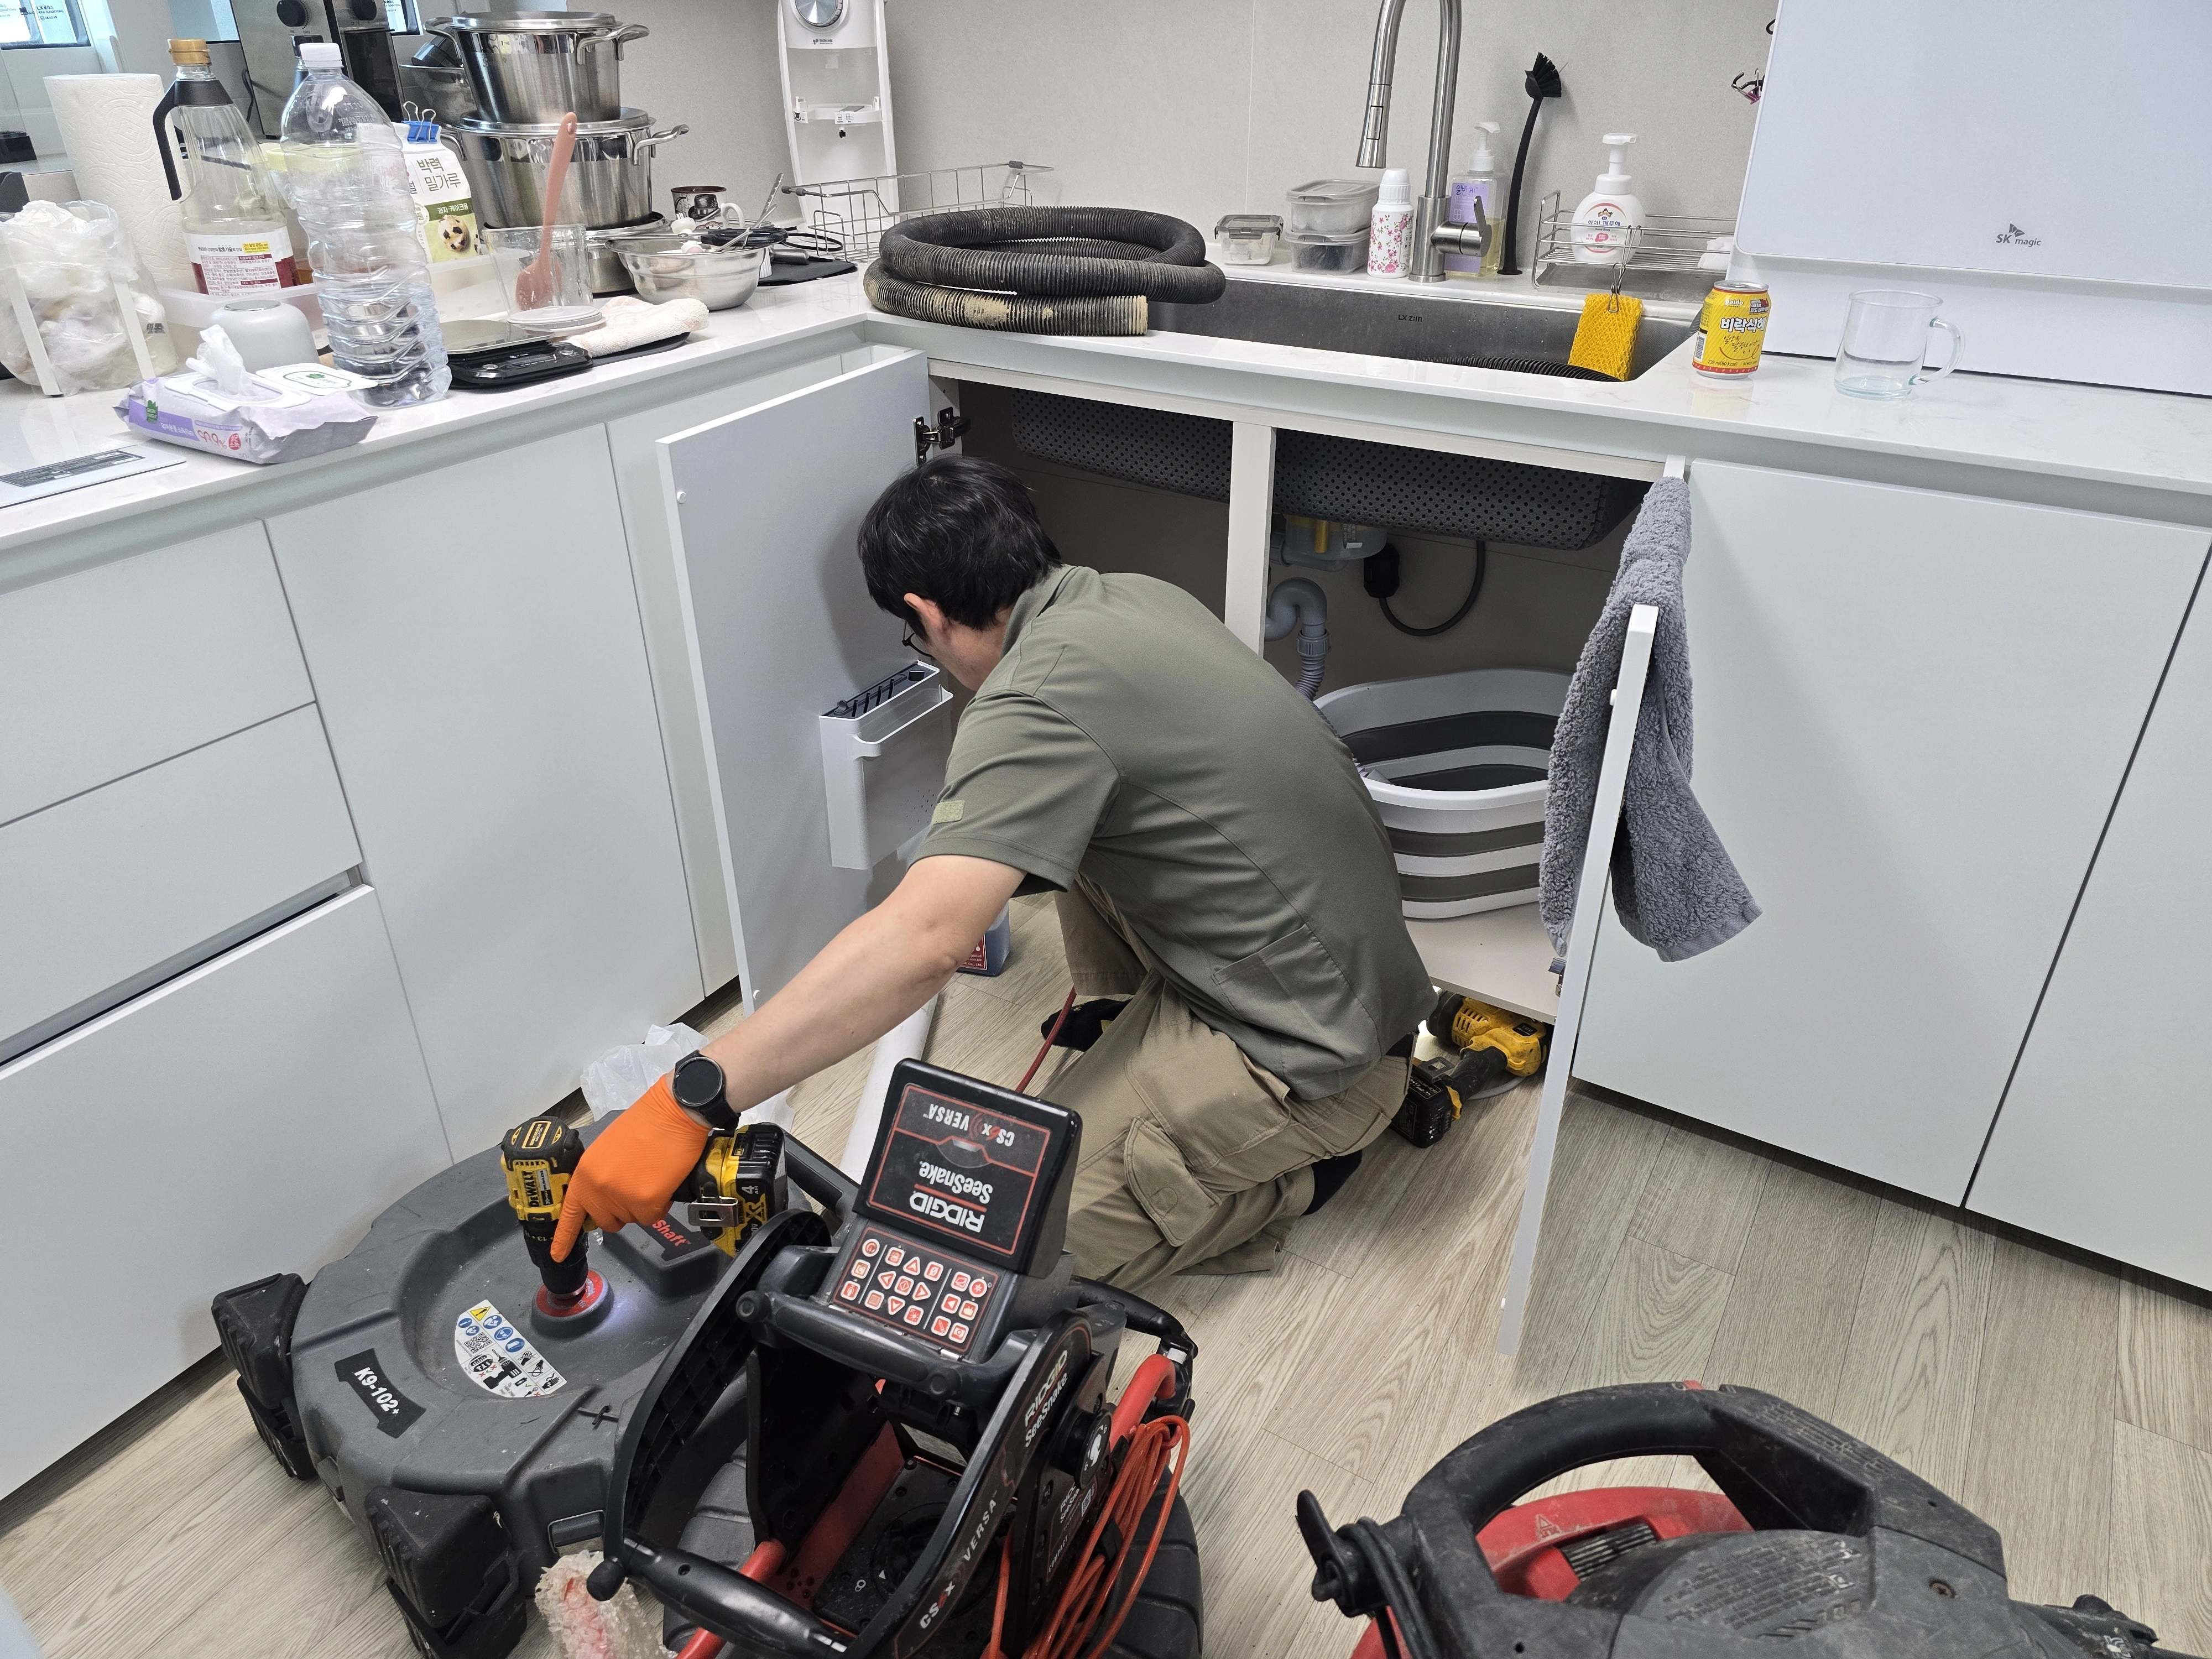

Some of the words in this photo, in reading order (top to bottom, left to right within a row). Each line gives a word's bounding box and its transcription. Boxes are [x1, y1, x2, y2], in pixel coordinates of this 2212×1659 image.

[416, 157, 445, 174] 박력
[424, 173, 461, 192] 밀가루
[1995, 234, 2012, 244] SK
[2015, 238, 2042, 248] magic
[1720, 316, 1767, 333] 비락식혜
[928, 1103, 970, 1131] VERSA
[521, 1170, 540, 1207] DEWALT
[742, 1185, 755, 1194] 4
[919, 1161, 993, 1204] SeeSnake
[909, 1191, 985, 1233] RIDGID
[652, 1219, 685, 1246] Shaft
[1024, 1349, 1068, 1427] RIDGID
[1025, 1372, 1068, 1448] SeeSnake
[963, 1499, 997, 1562] VERSA
[1048, 1534, 1068, 1573] COMPACT
